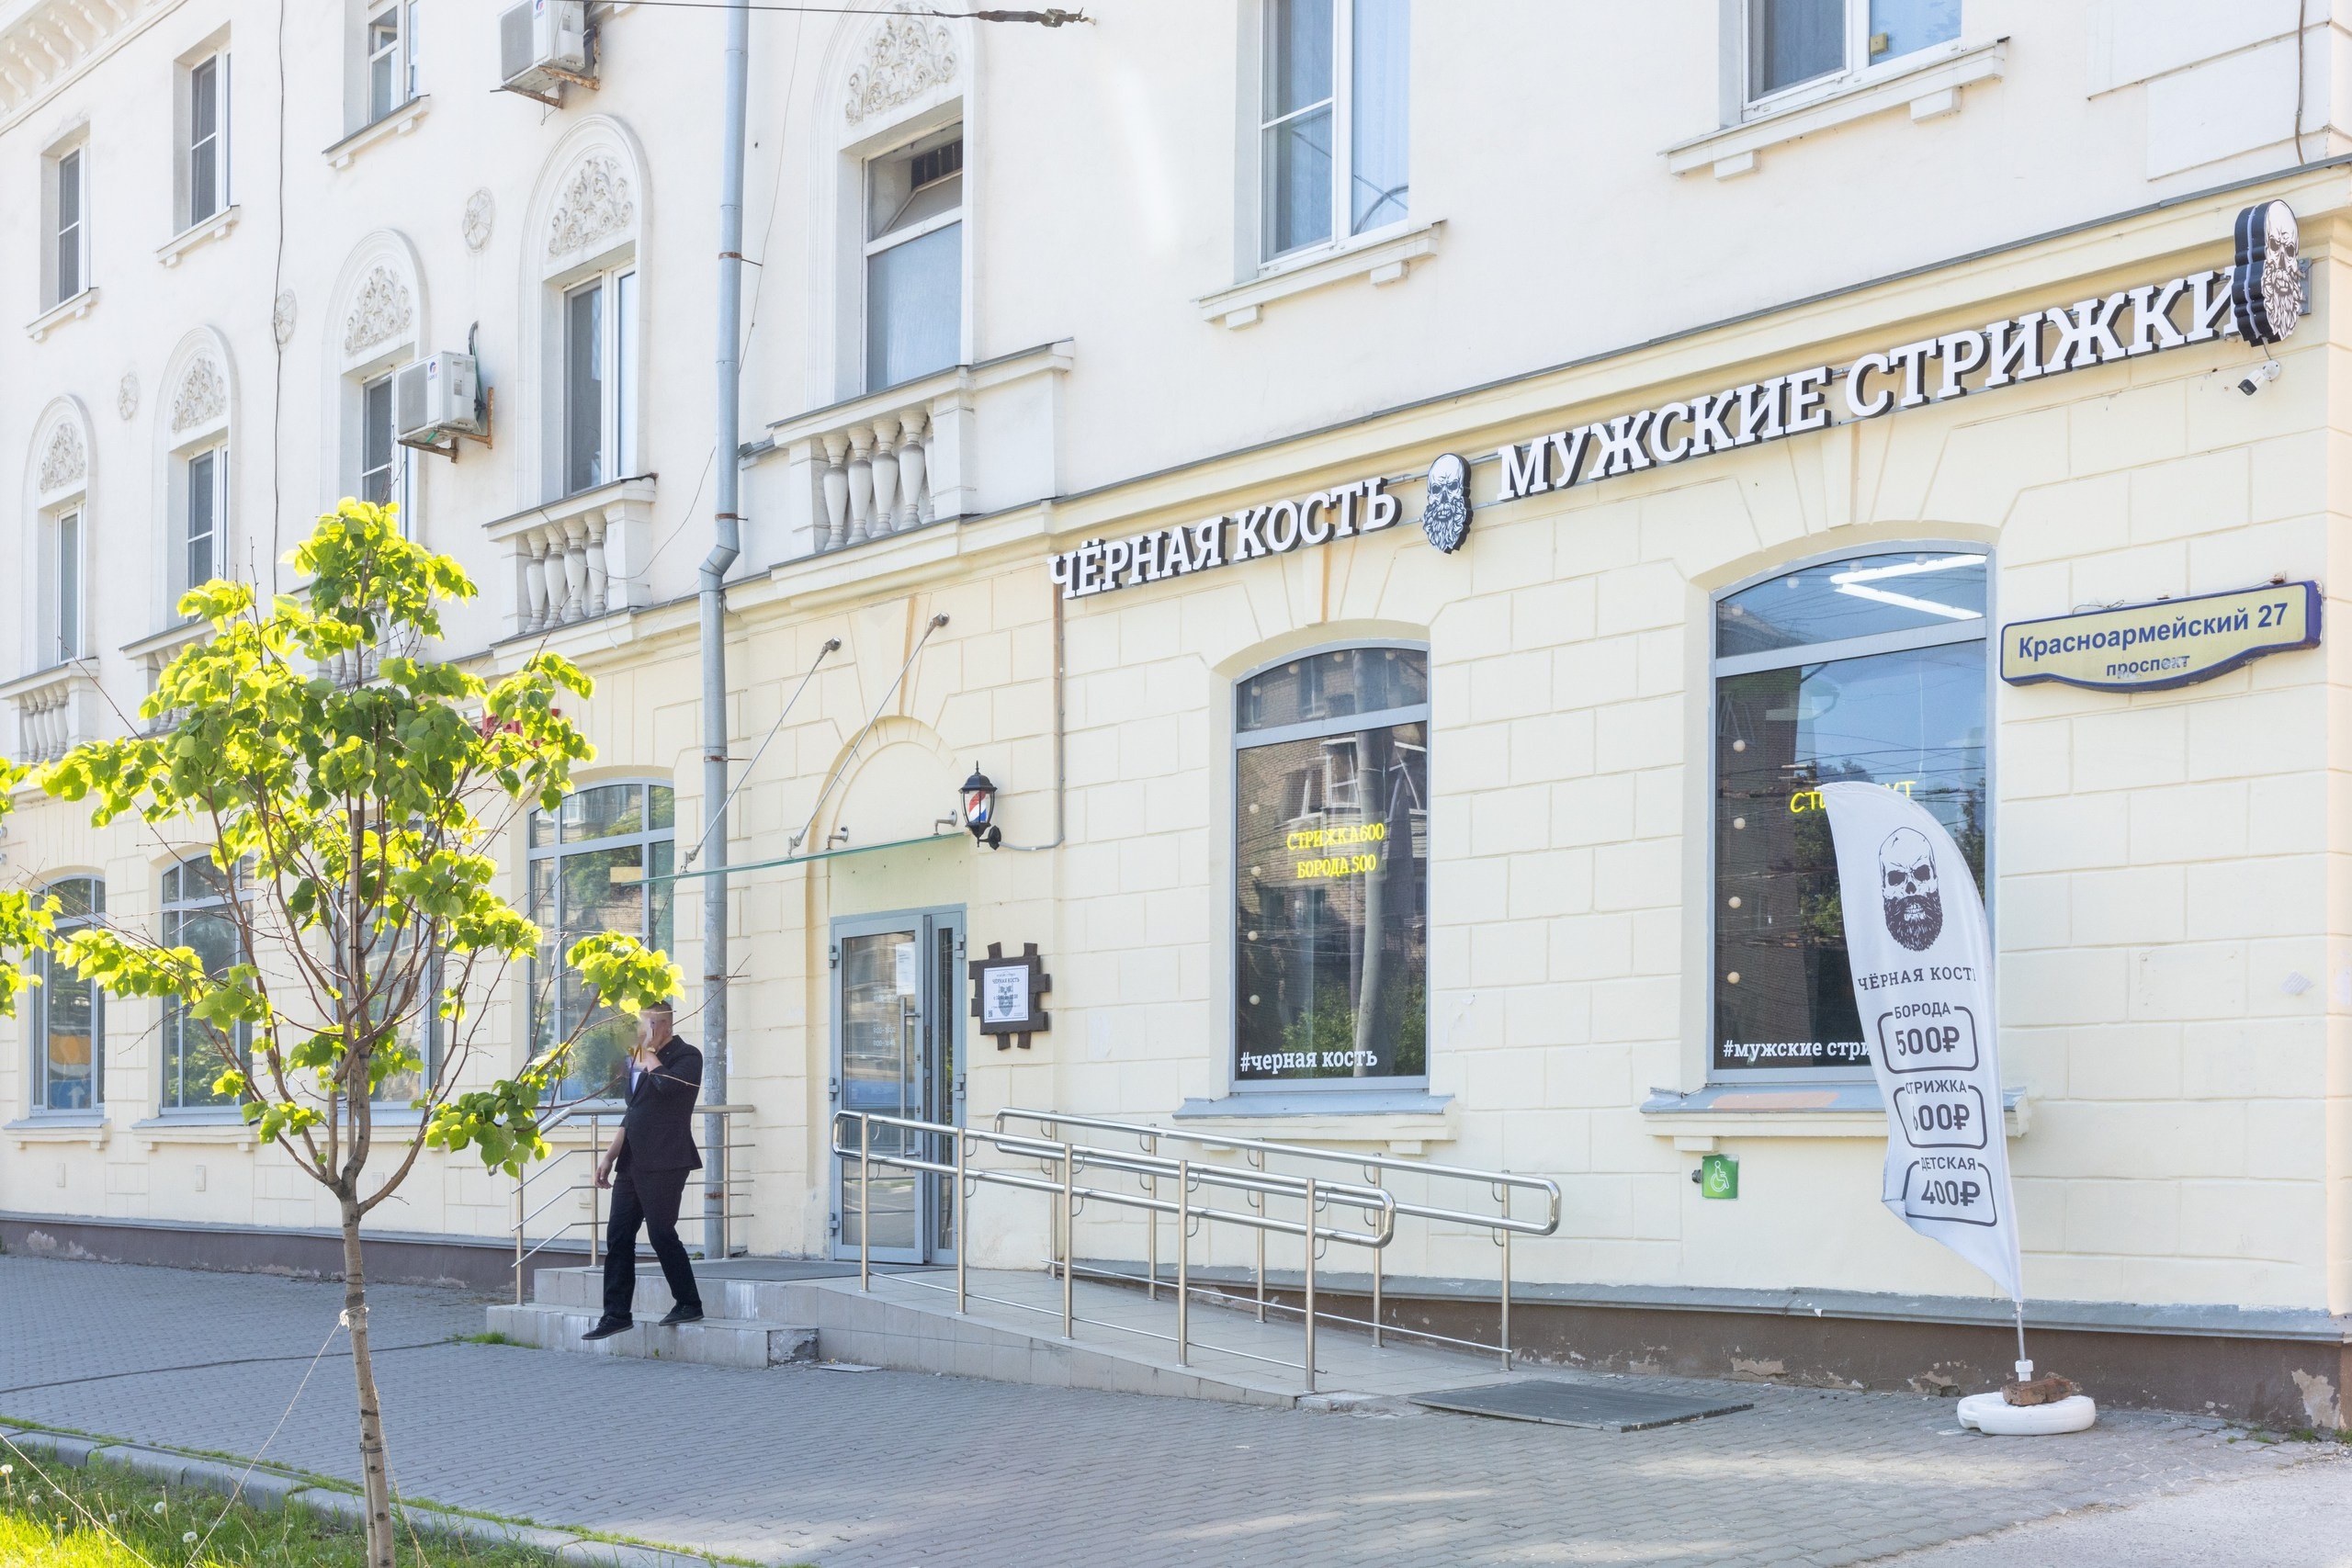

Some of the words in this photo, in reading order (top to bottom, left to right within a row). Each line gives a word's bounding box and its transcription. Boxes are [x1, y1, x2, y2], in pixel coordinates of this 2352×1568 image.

[1497, 366, 1833, 502] МУЖСКИЕ
[1845, 265, 2240, 419] СТРИЖКИ
[1047, 515, 1229, 600] ЧЁРНАЯ
[1234, 477, 1402, 561] КОСТЬ
[2018, 607, 2249, 661] Красноармейский
[2257, 603, 2289, 628] 27
[2107, 655, 2190, 678] проспект
[1297, 857, 1350, 879] БОРОДА
[1858, 968, 1925, 991] ЧЁРНАЯ
[1894, 1001, 1951, 1020] БОРОДА
[1724, 1039, 1823, 1062] #мужские
[1240, 1051, 1317, 1075] #черная
[1322, 1050, 1378, 1067] кость
[1905, 1079, 1967, 1095] СТРИЖКА
[1921, 1156, 1976, 1171] ДЕТСКАЯ
